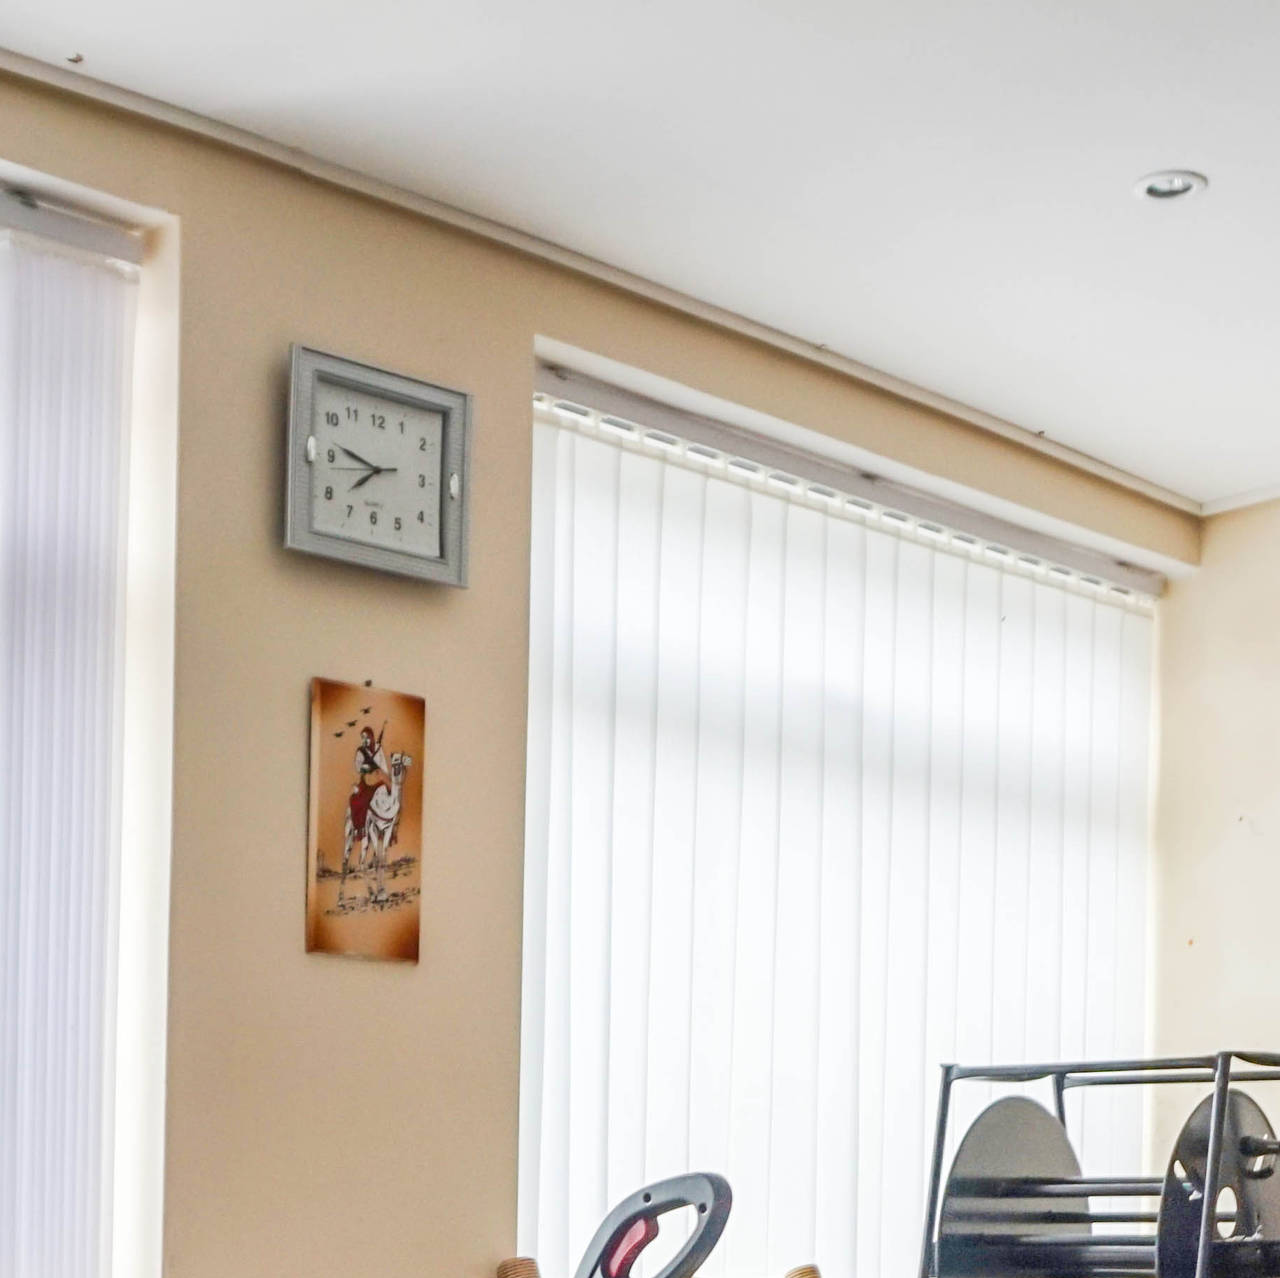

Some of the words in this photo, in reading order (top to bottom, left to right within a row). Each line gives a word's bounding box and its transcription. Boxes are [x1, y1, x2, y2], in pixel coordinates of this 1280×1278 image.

[325, 412, 339, 427] 10
[345, 407, 359, 422] 11
[371, 414, 386, 430] 12
[398, 422, 405, 434] 1
[419, 437, 427, 451] 2
[327, 449, 336, 463] 9
[418, 474, 426, 488] 3
[324, 486, 333, 501] 8
[346, 504, 354, 518] 7
[369, 511, 378, 525] 6
[417, 510, 425, 524] 4
[393, 517, 402, 531] 5
